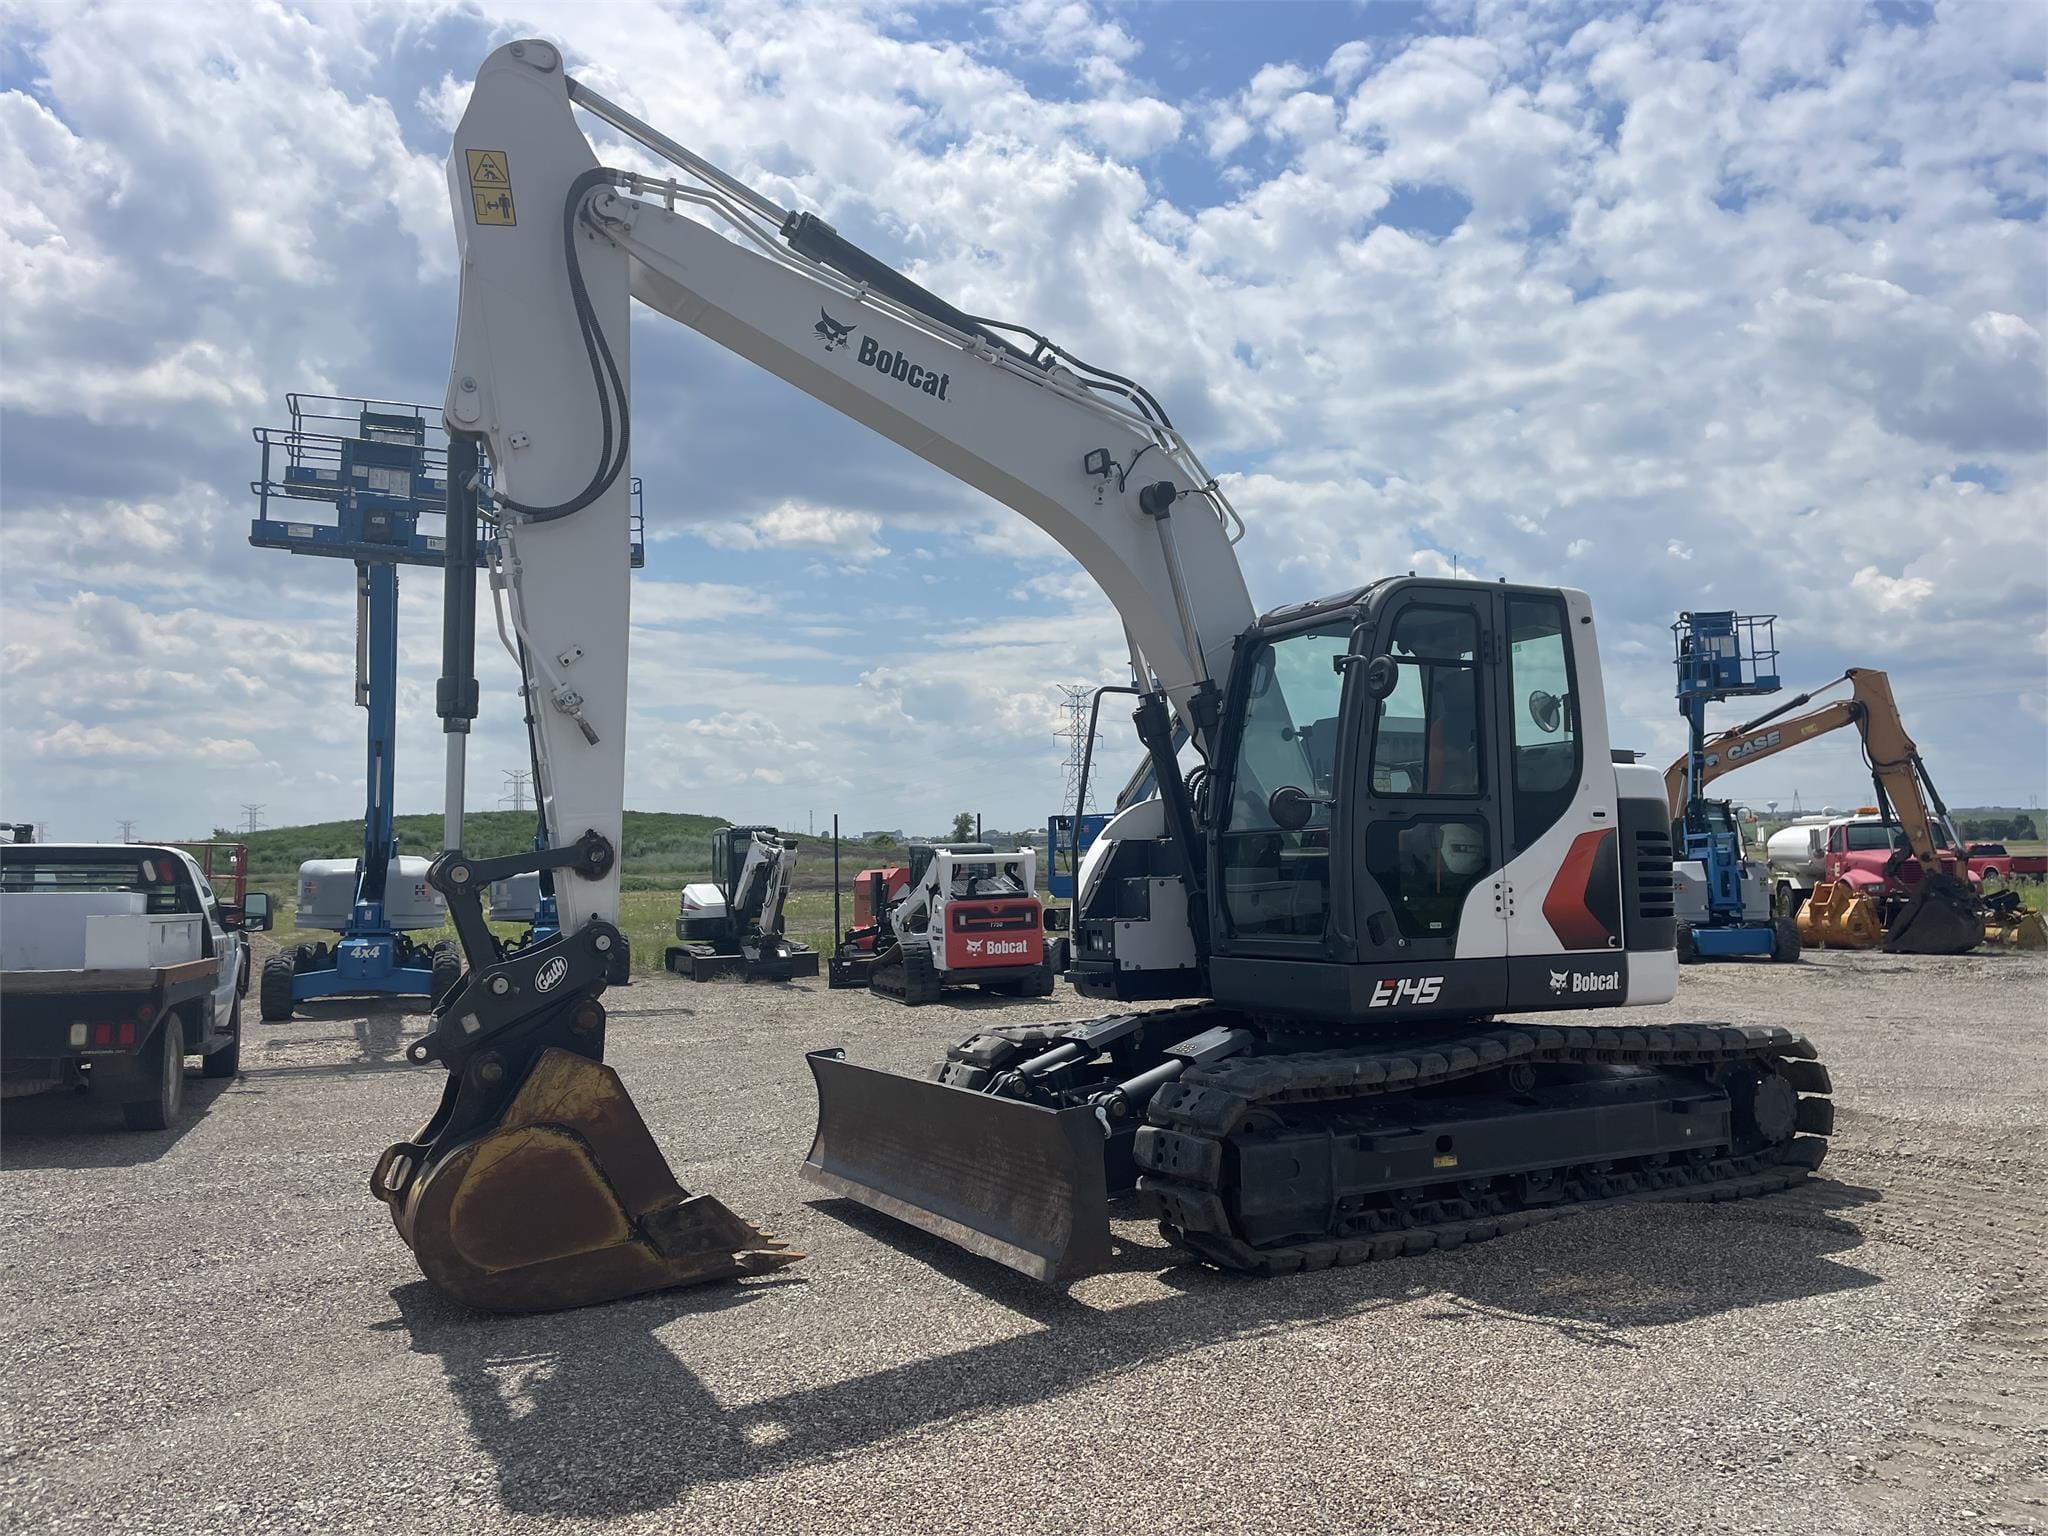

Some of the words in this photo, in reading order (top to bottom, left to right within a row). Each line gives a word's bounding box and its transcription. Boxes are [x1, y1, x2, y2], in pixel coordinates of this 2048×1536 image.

[857, 335, 949, 401] Bobcat
[1727, 731, 1780, 761] CASE
[350, 946, 380, 958] 4x4
[986, 940, 1028, 955] Bobcat
[1368, 976, 1444, 1007] E145
[1572, 971, 1619, 992] Bobcat
